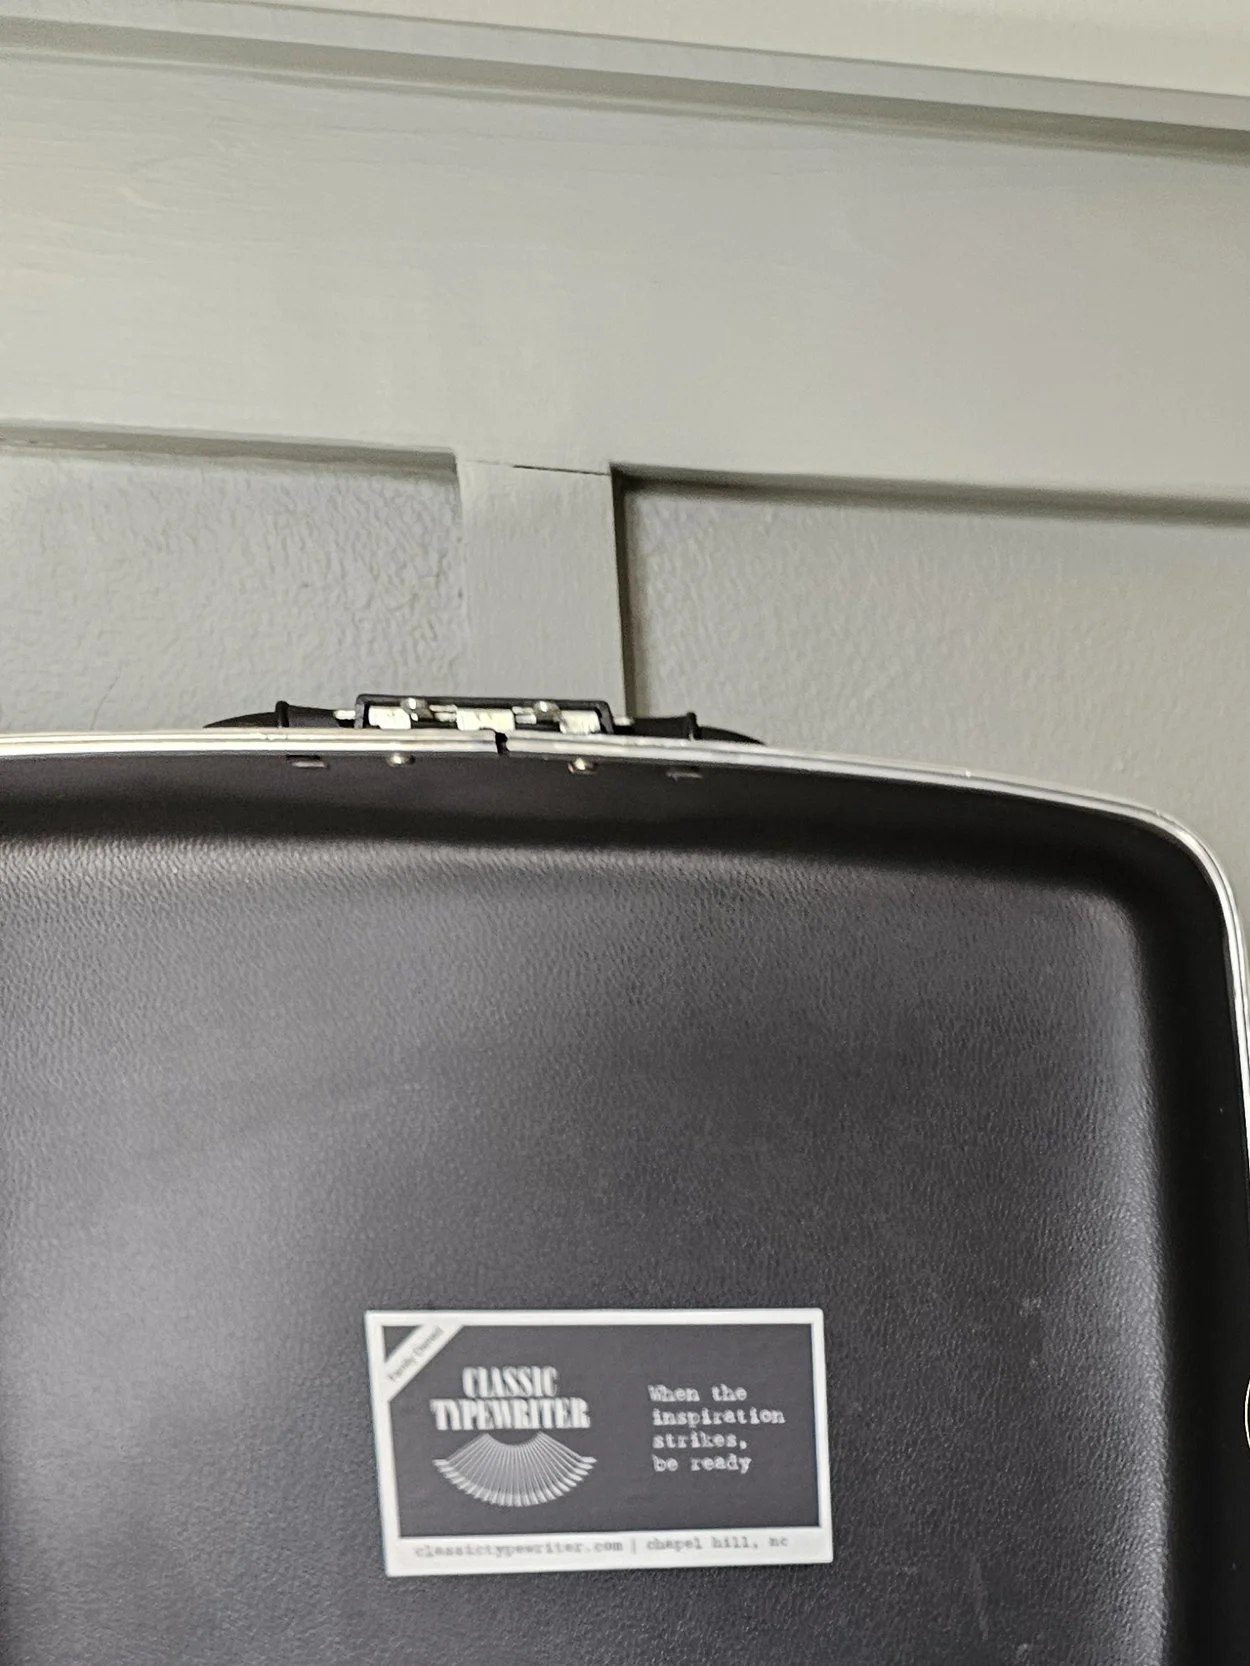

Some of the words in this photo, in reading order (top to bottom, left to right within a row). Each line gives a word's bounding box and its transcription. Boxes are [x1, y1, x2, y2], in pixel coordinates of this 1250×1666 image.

[462, 1365, 558, 1398] CLASSIC
[648, 1384, 700, 1402] When
[711, 1383, 747, 1401] the
[430, 1397, 591, 1431] TYPEWRITER
[652, 1406, 786, 1428] inspiration
[652, 1430, 747, 1450] strikes,
[651, 1453, 679, 1472] be
[689, 1453, 752, 1474] ready
[646, 1535, 703, 1553] chapel
